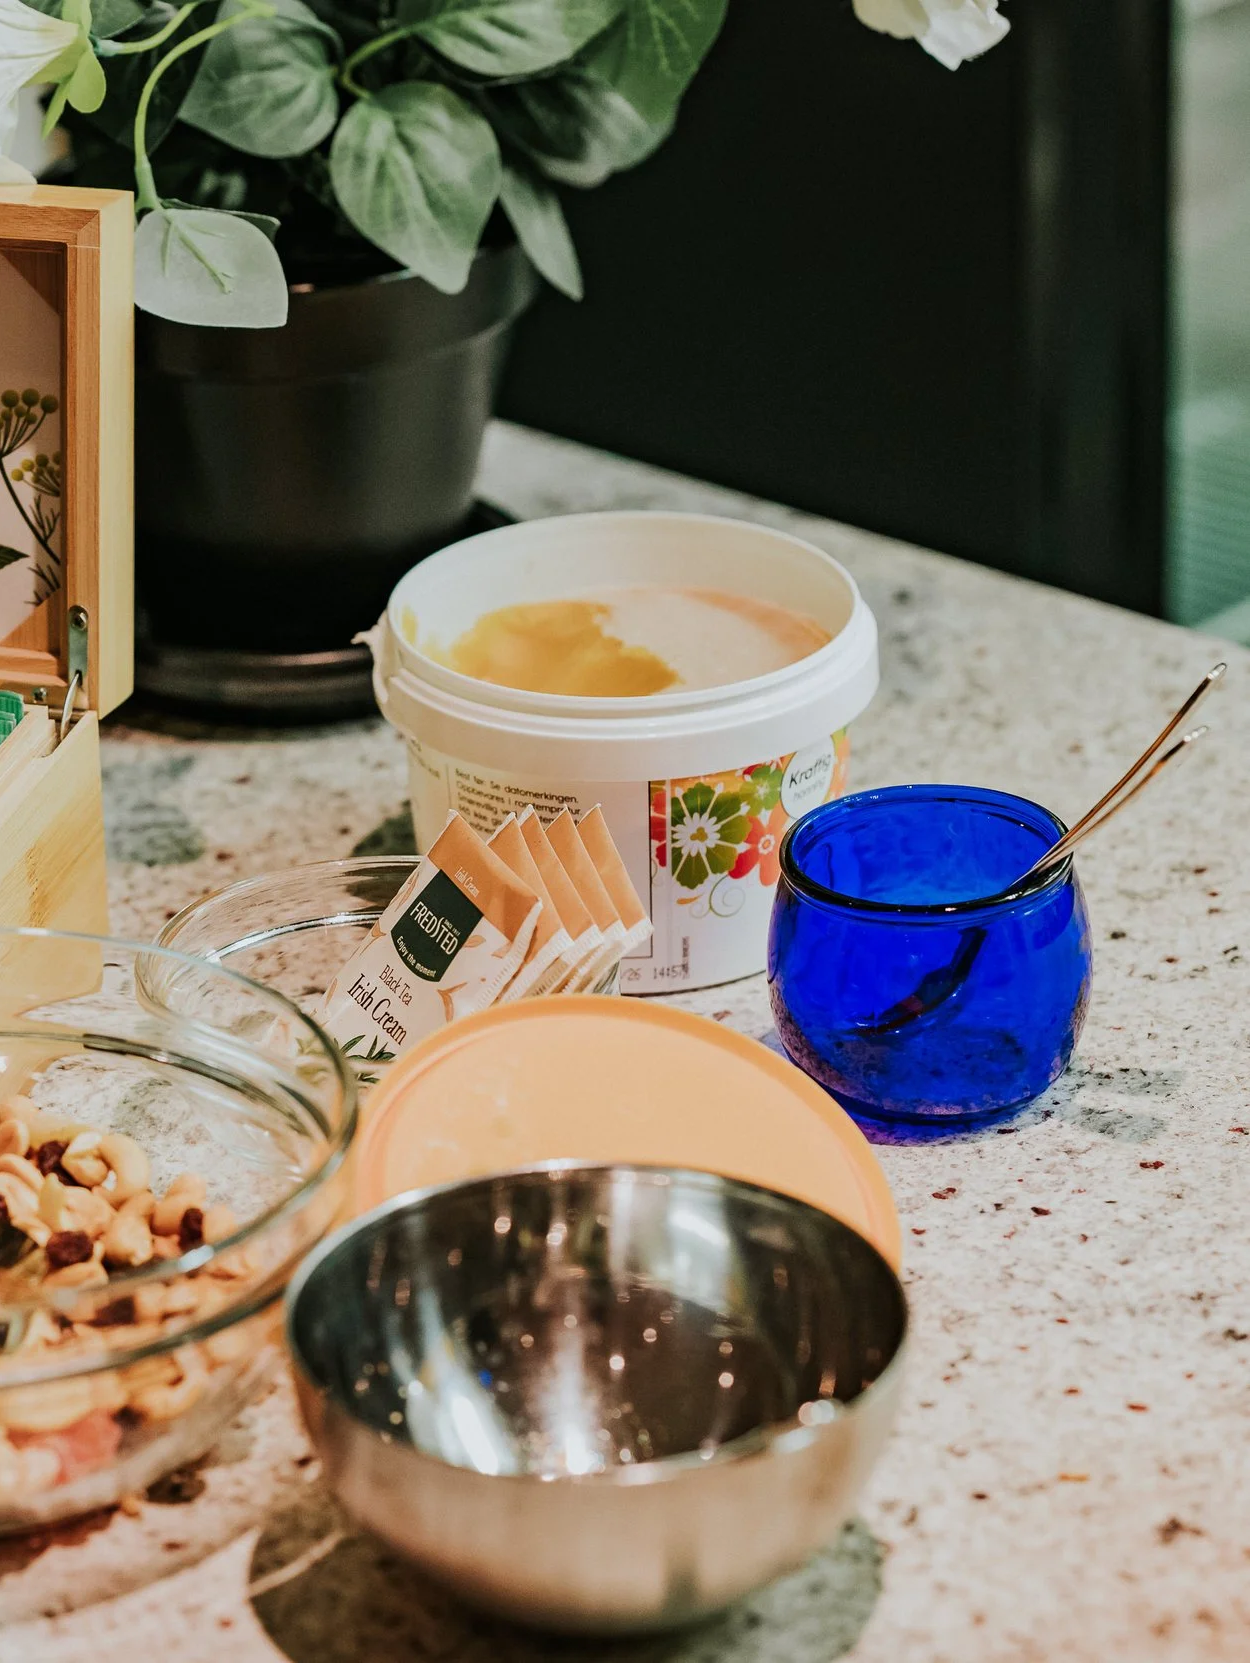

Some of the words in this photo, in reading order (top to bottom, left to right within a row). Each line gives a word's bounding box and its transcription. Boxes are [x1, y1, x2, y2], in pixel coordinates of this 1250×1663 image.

[504, 785, 578, 804] datomerkingen.
[410, 901, 458, 955] FREDSTED
[396, 935, 409, 957] Enjoy
[406, 953, 416, 966] the
[415, 962, 437, 977] moment
[379, 964, 402, 994] Black
[398, 983, 413, 1006] Tea
[347, 973, 377, 1011] Irish
[371, 998, 407, 1045] Cream
